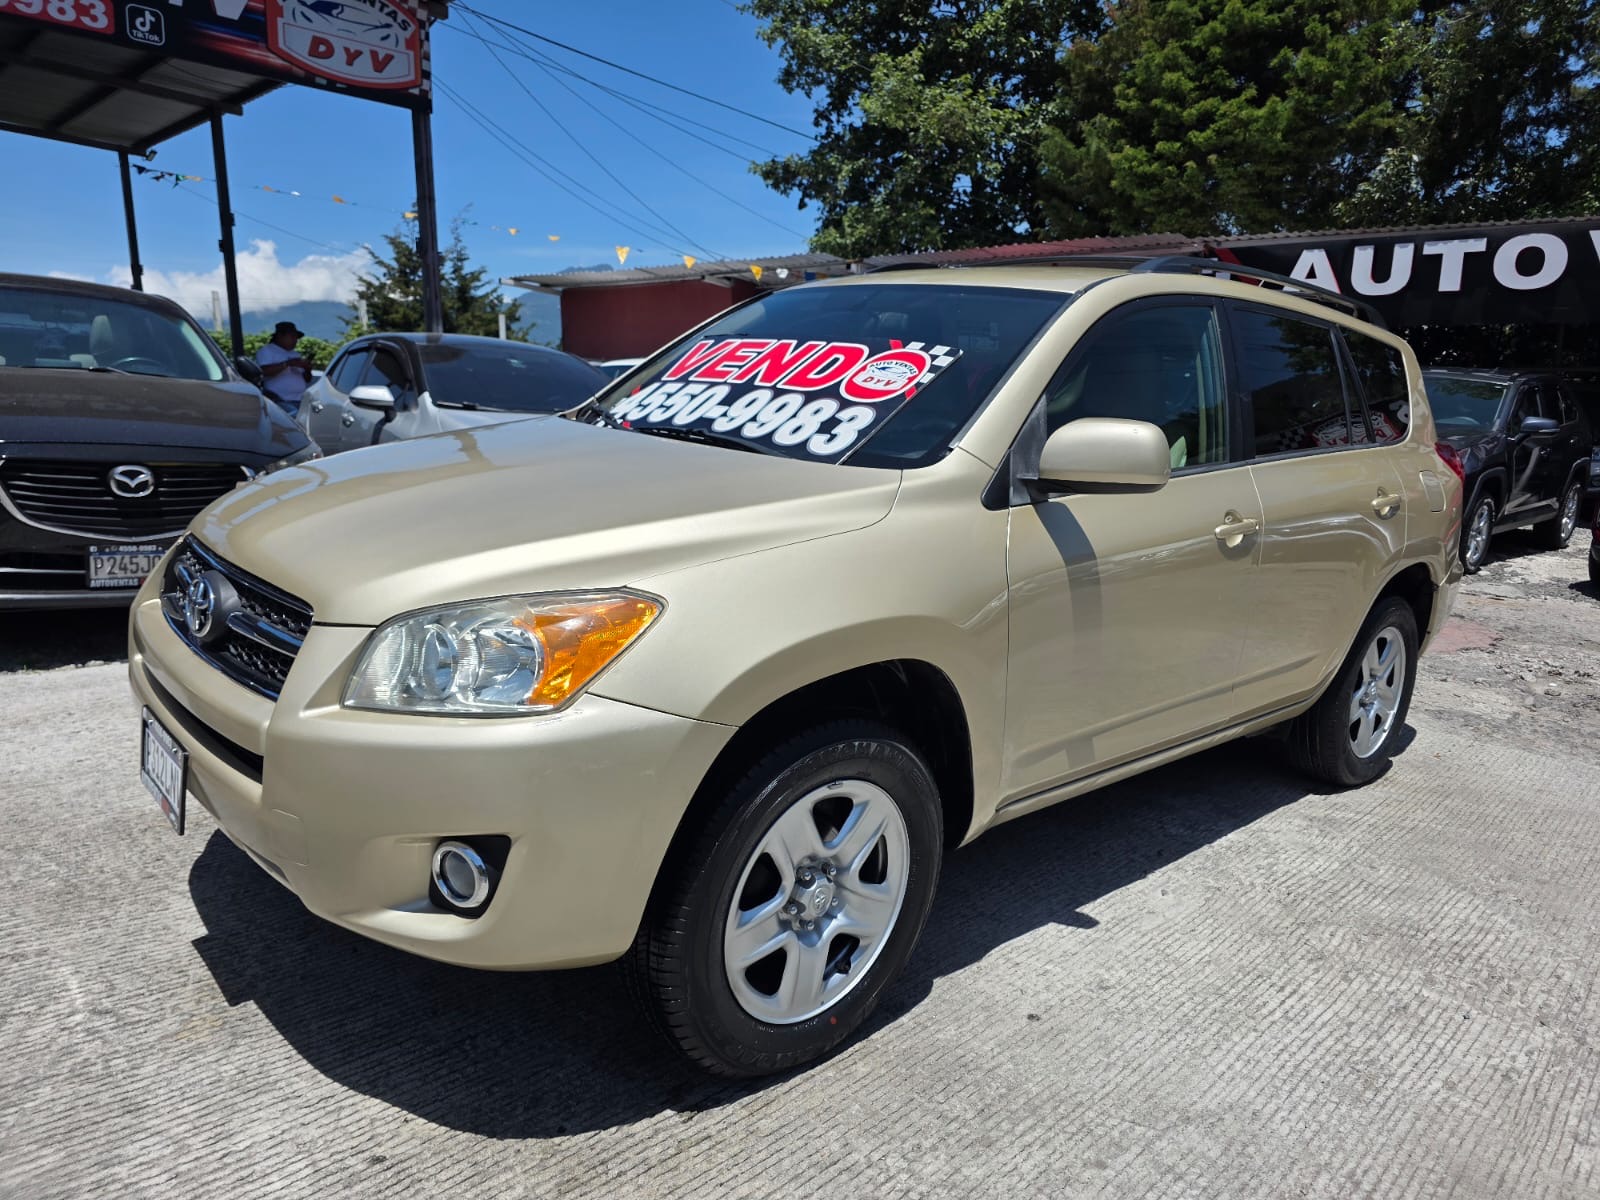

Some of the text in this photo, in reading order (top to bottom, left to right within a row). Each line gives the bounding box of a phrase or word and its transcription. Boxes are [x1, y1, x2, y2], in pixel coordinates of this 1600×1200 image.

[131, 29, 161, 43] TikTok
[356, 0, 411, 31] NTAS
[1282, 232, 1569, 296] AUTO
[609, 381, 876, 455] 4550-9983
